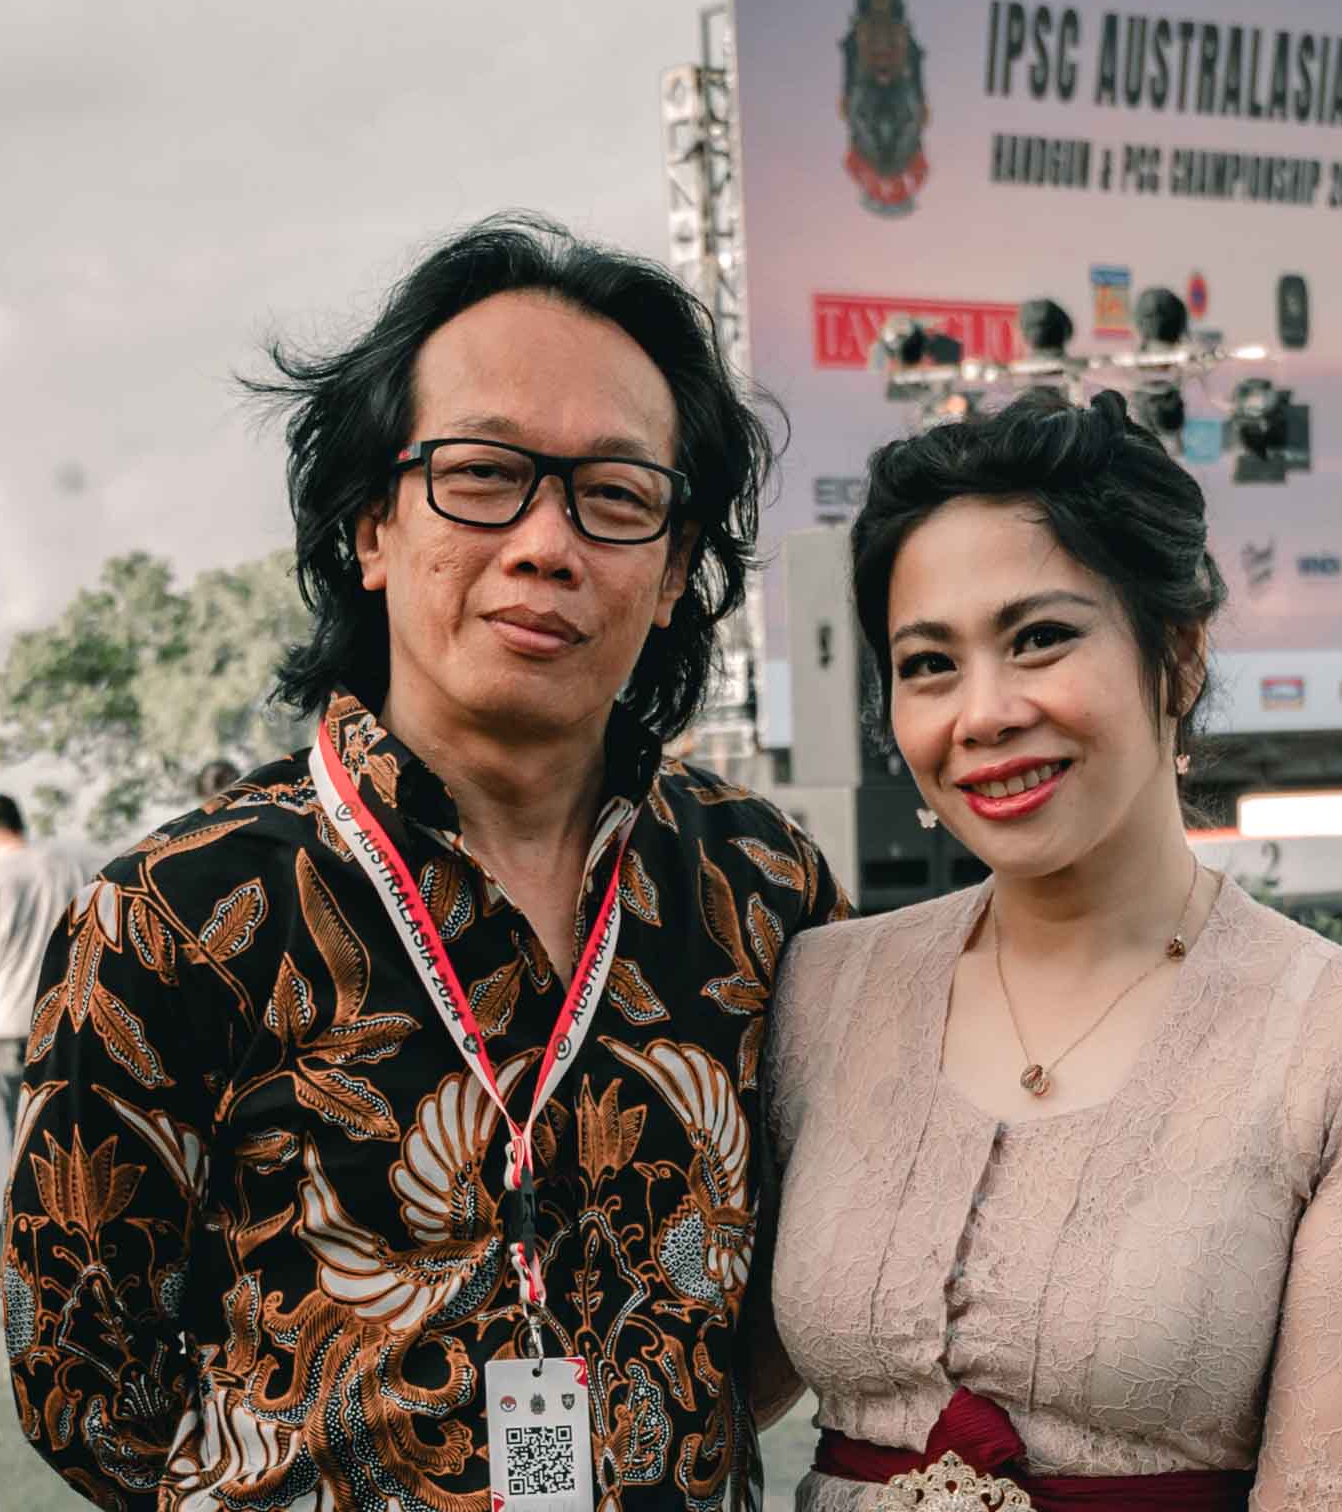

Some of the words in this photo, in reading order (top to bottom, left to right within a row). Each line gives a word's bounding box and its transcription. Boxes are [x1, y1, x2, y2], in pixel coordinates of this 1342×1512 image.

[985, 0, 1080, 102] IPSC
[990, 133, 1092, 189] HANDGUN
[1170, 148, 1322, 207] CHAMPIONSHIP
[1261, 841, 1282, 886] 2
[354, 829, 439, 971] AUSTRALASIA
[432, 975, 464, 1023] 2024
[568, 896, 618, 1025] AUSTRALAS
